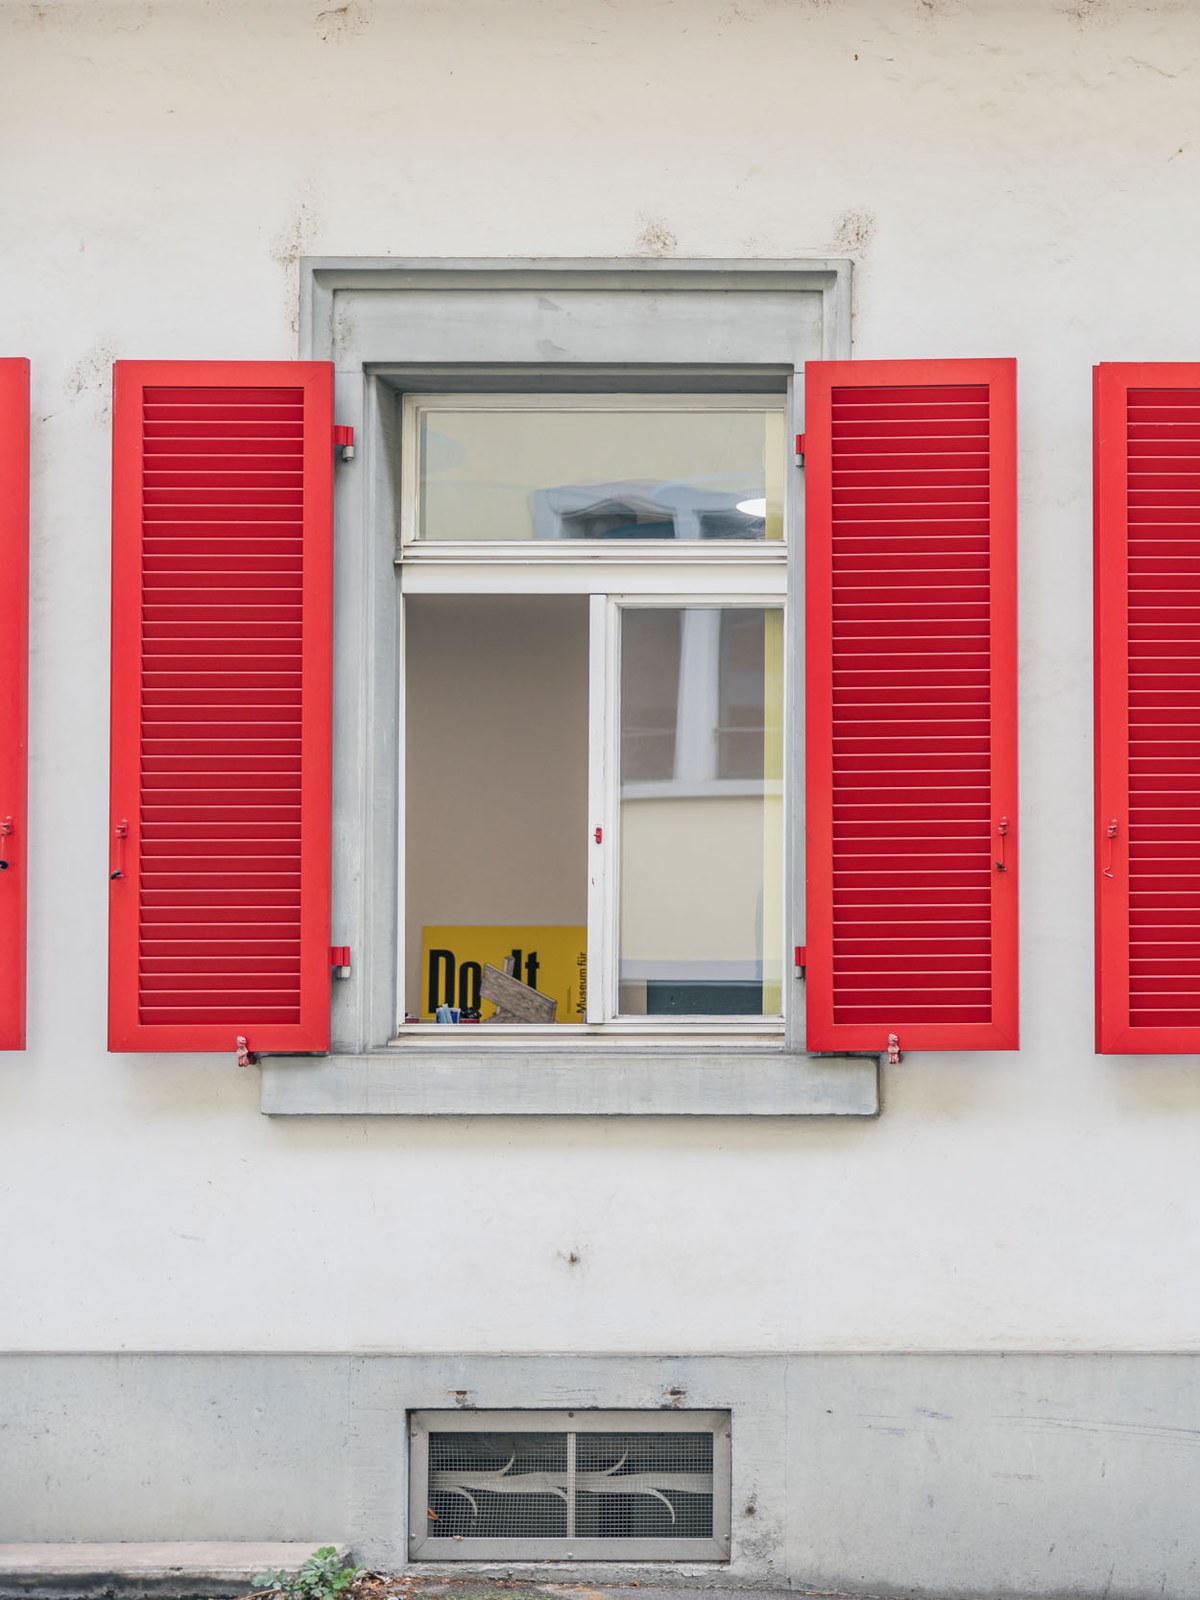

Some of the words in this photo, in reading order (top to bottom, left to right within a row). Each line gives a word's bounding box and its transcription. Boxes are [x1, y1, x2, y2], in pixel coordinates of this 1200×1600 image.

[428, 949, 482, 1014] Do
[576, 952, 587, 966] für
[576, 967, 587, 1014] Museum
